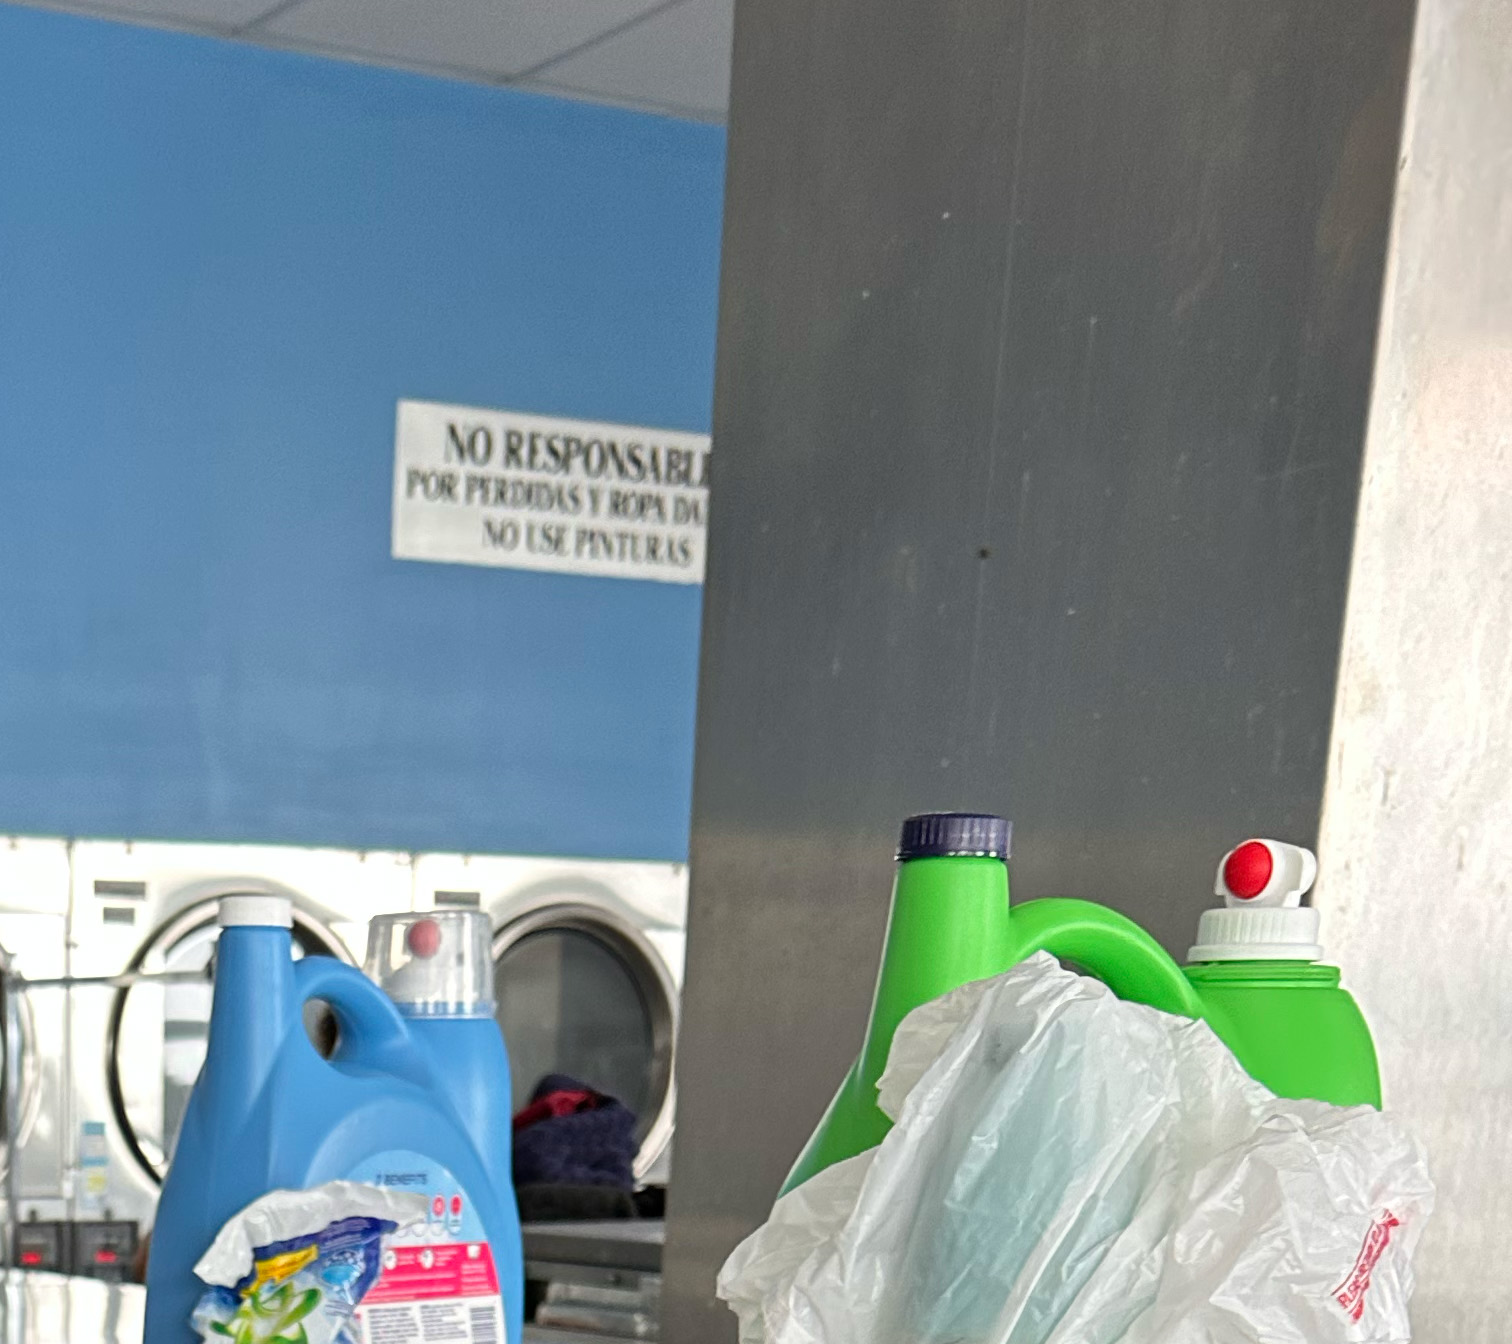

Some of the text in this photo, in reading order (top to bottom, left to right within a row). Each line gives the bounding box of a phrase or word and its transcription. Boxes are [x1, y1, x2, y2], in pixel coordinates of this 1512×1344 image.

[445, 422, 493, 466] NO
[405, 466, 460, 501] POR
[464, 473, 582, 514] PERDIDAS
[585, 485, 602, 518] Y
[609, 487, 667, 524] ROPA
[483, 517, 693, 568] NO USE PINTURAS
